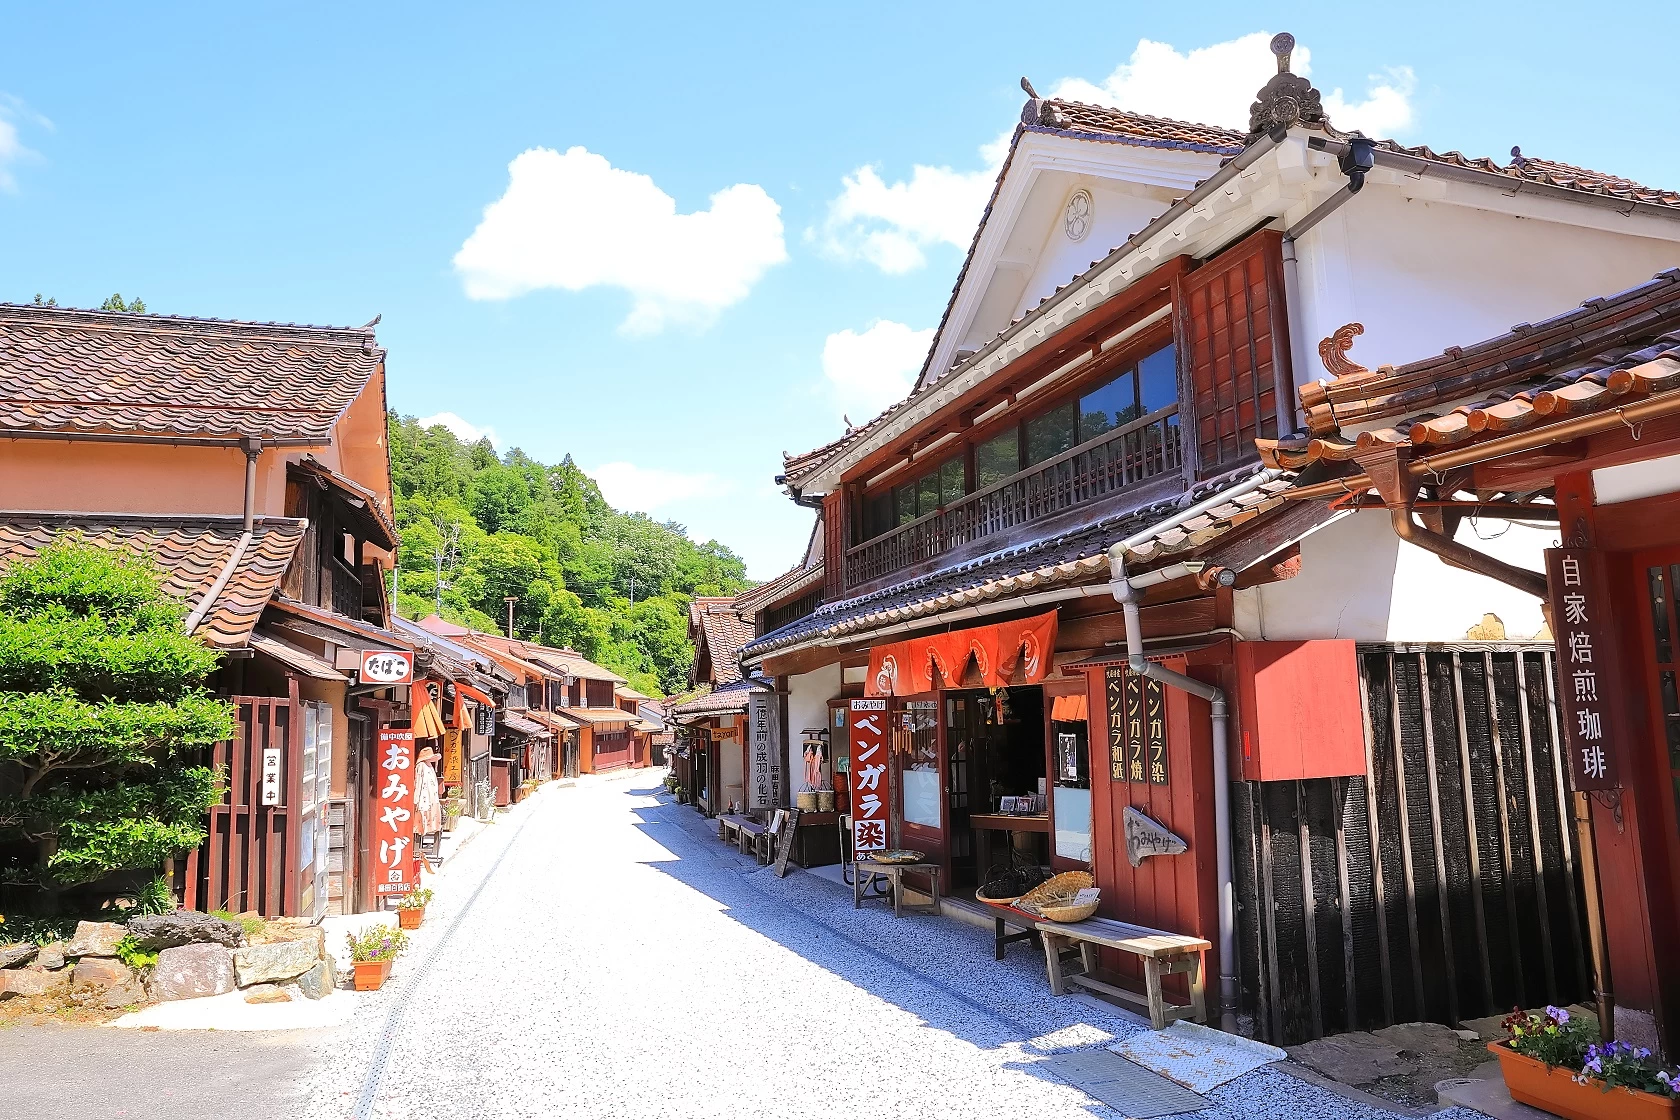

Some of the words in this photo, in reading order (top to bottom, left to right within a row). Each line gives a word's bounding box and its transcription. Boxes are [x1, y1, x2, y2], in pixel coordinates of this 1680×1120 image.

[369, 657, 406, 676] たばこ
[853, 700, 884, 710] おみやげ
[1561, 554, 1607, 779] 自家焙煎珈琲
[265, 755, 277, 801] 営業中
[712, 729, 738, 739] tayori
[755, 699, 768, 805] 二億年前の成羽の化石
[1108, 679, 1124, 779] ベンガラ和紙
[1127, 678, 1143, 781] ベンガラ焼
[1147, 678, 1165, 783] ベンガラ染
[380, 743, 411, 869] おみやげ
[853, 714, 887, 849] ベンガラ染
